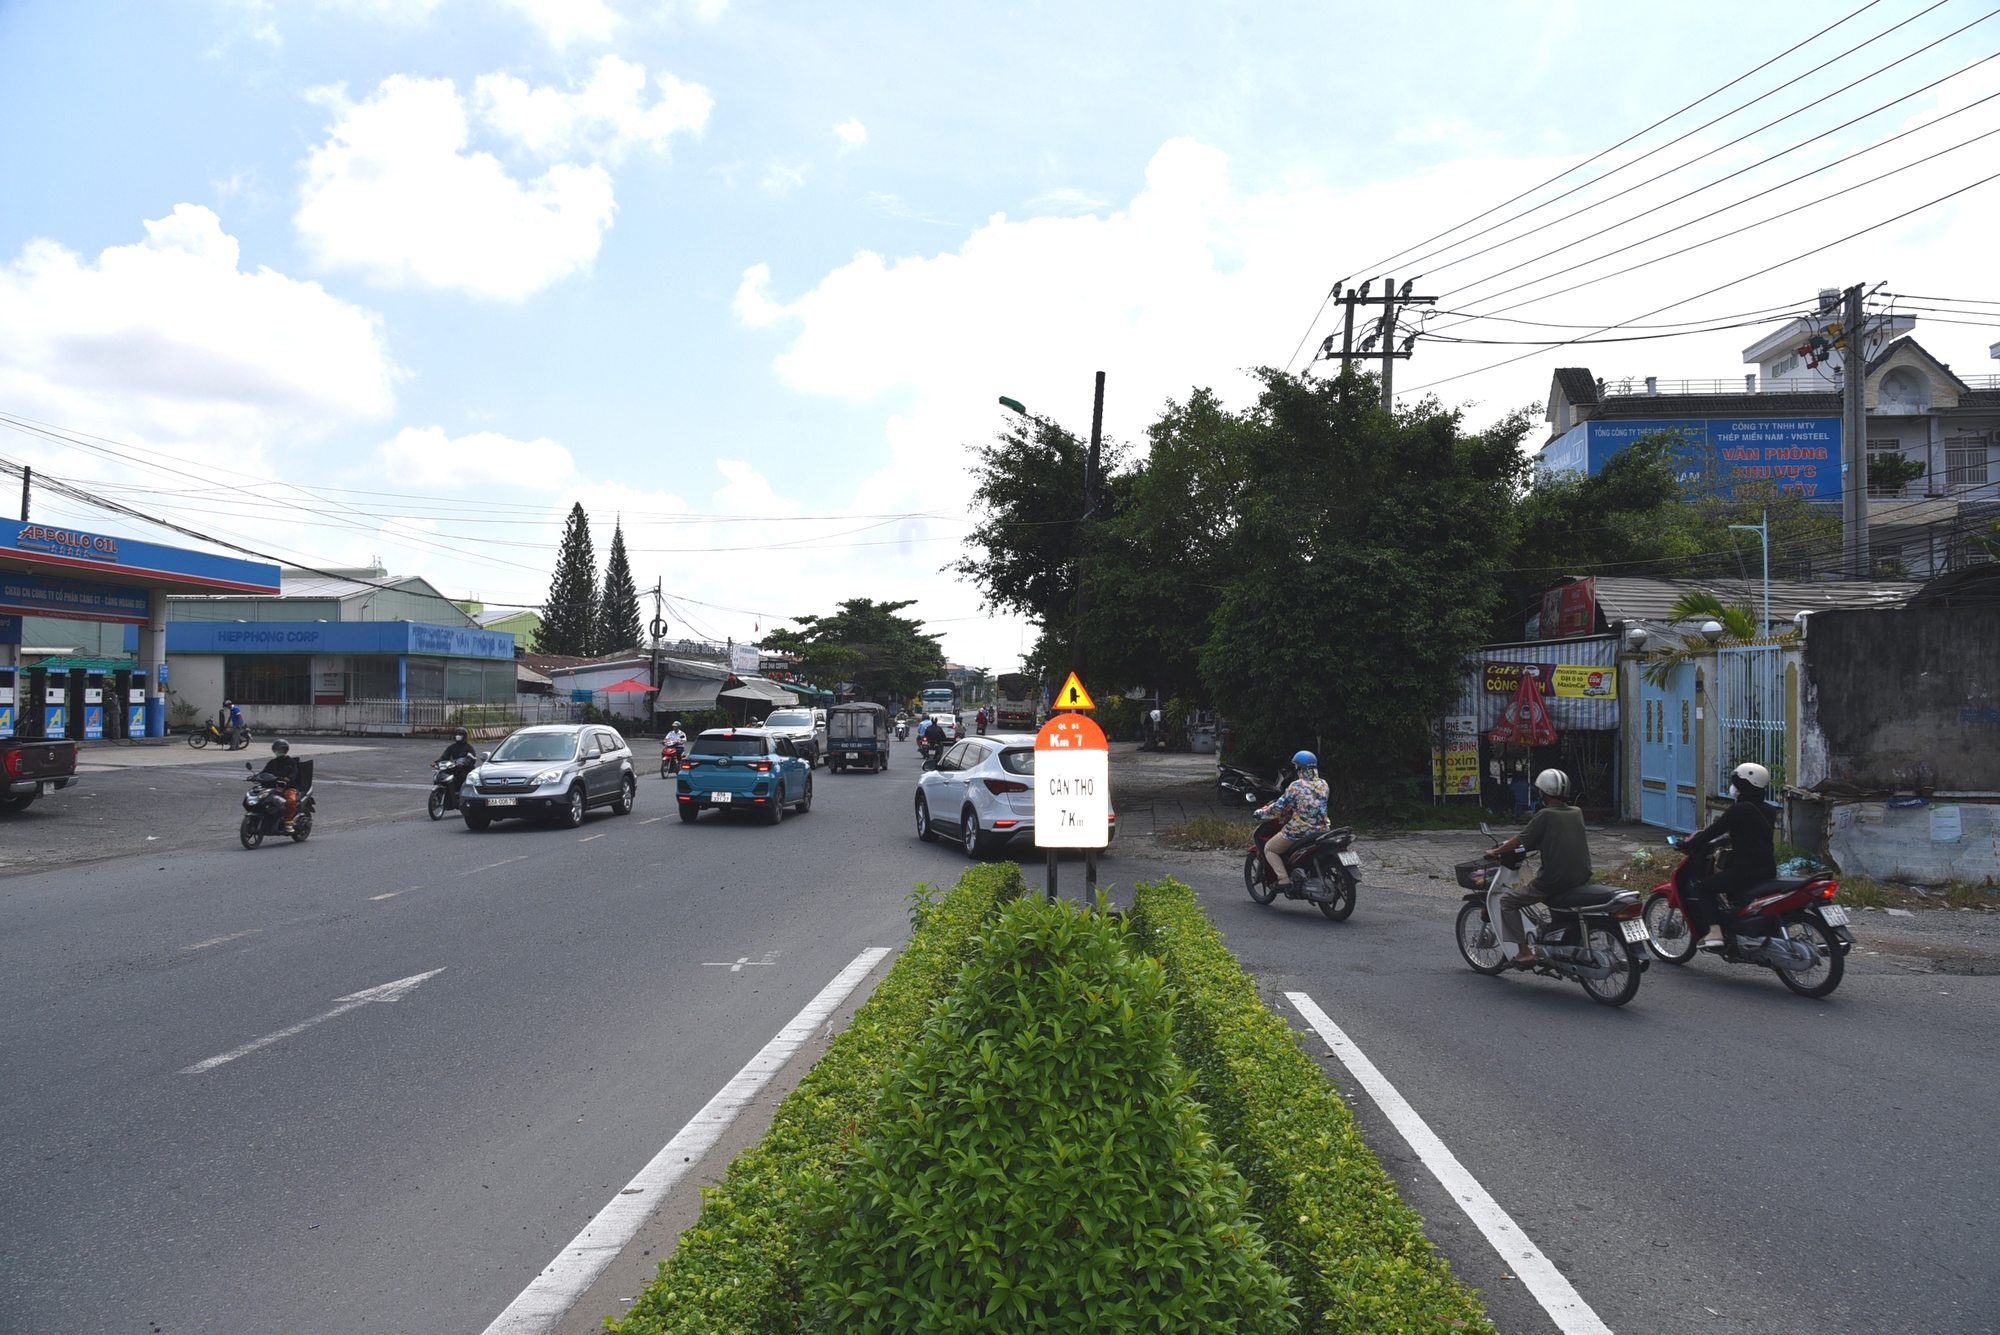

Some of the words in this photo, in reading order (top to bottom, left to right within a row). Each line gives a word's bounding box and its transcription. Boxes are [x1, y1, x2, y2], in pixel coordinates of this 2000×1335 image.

[1594, 426, 1610, 437] TỔNG
[1611, 426, 1628, 437] CÔNG
[1628, 428, 1637, 437] TY
[1732, 421, 1754, 431] CÔNG
[1756, 423, 1769, 431] TY
[1772, 423, 1795, 431] TNHH
[1798, 422, 1815, 430] MTV
[1717, 431, 1739, 442] THÉP
[1741, 430, 1763, 441] MIỀN
[1791, 432, 1829, 441] VNSTEEL
[1722, 445, 1760, 461] VĂN
[1765, 444, 1828, 460] PHÒNG
[1733, 465, 1771, 479] KHU
[1774, 465, 1817, 481] VỰC
[1782, 480, 1818, 497] TÂY
[18, 525, 92, 548] APPOLLO
[94, 537, 118, 553] OIL
[31, 587, 47, 600] CÔNG
[48, 590, 55, 600] TY
[218, 631, 284, 643] HIEPPHONG
[287, 631, 319, 643] CORP
[674, 643, 700, 653] COFFEE
[1486, 677, 1518, 691] CÔNG
[1050, 734, 1070, 747] Km
[1074, 734, 1083, 747] 7
